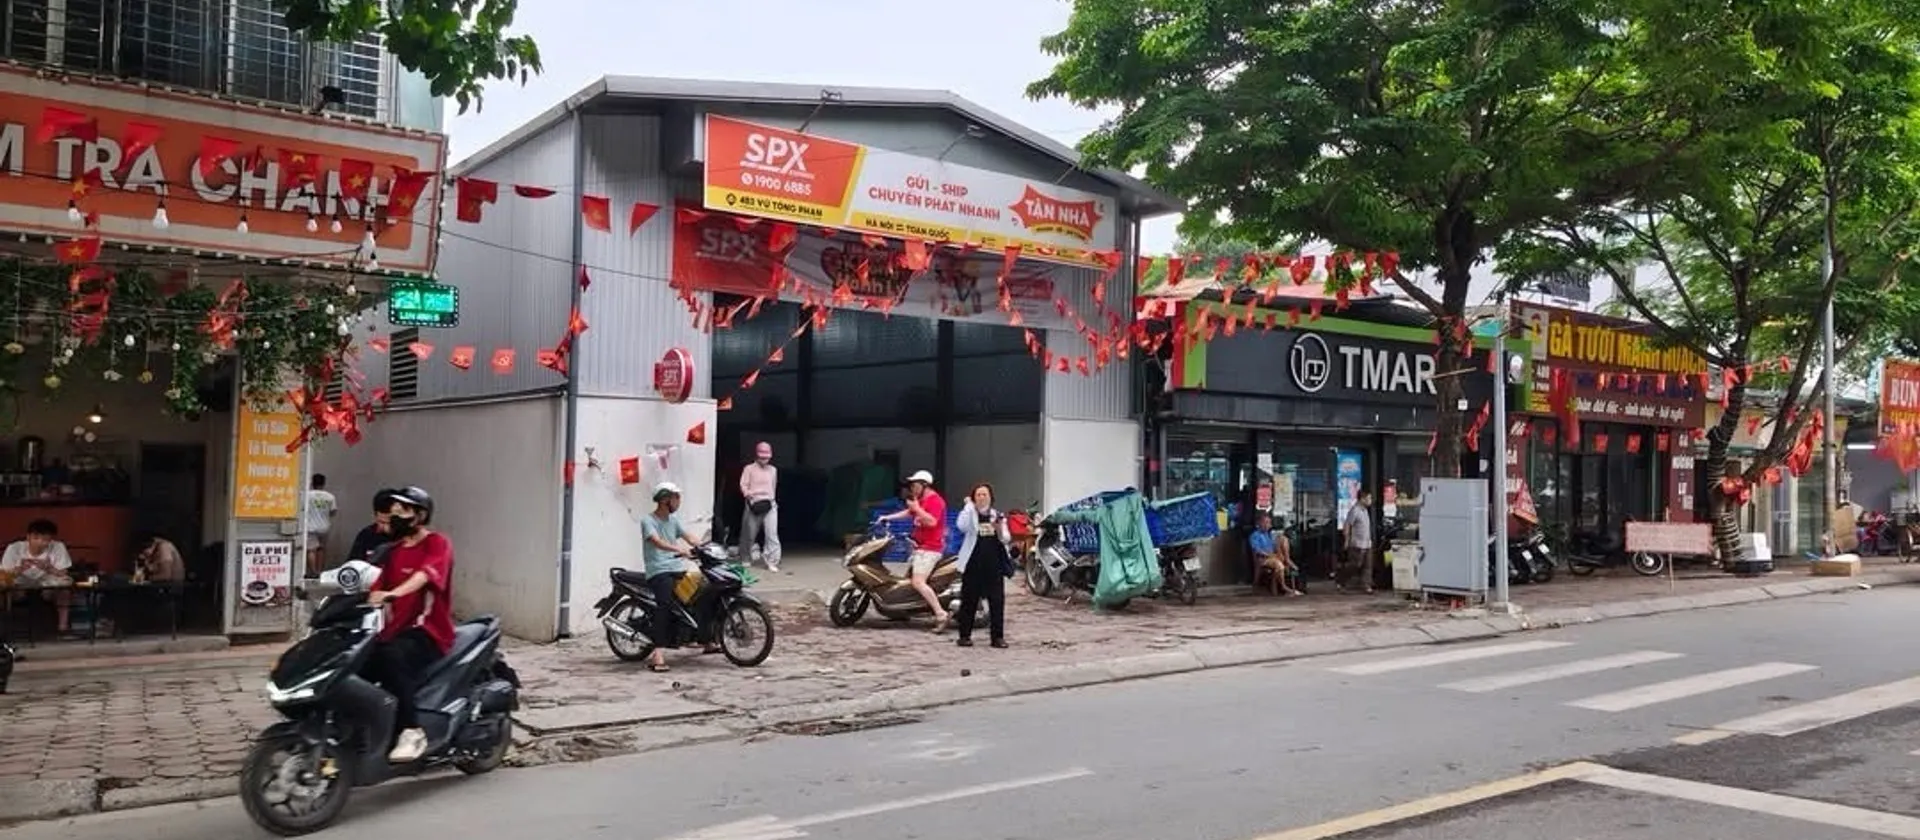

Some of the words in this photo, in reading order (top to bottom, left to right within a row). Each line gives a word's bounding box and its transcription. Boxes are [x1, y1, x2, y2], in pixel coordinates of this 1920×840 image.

[745, 133, 810, 173] SPX
[755, 174, 781, 190] 1900
[941, 183, 968, 198] SHIP
[798, 204, 823, 216] PHAN
[959, 204, 1000, 220] NHANH
[702, 227, 760, 262] SPX
[1550, 315, 1573, 358] GÀ
